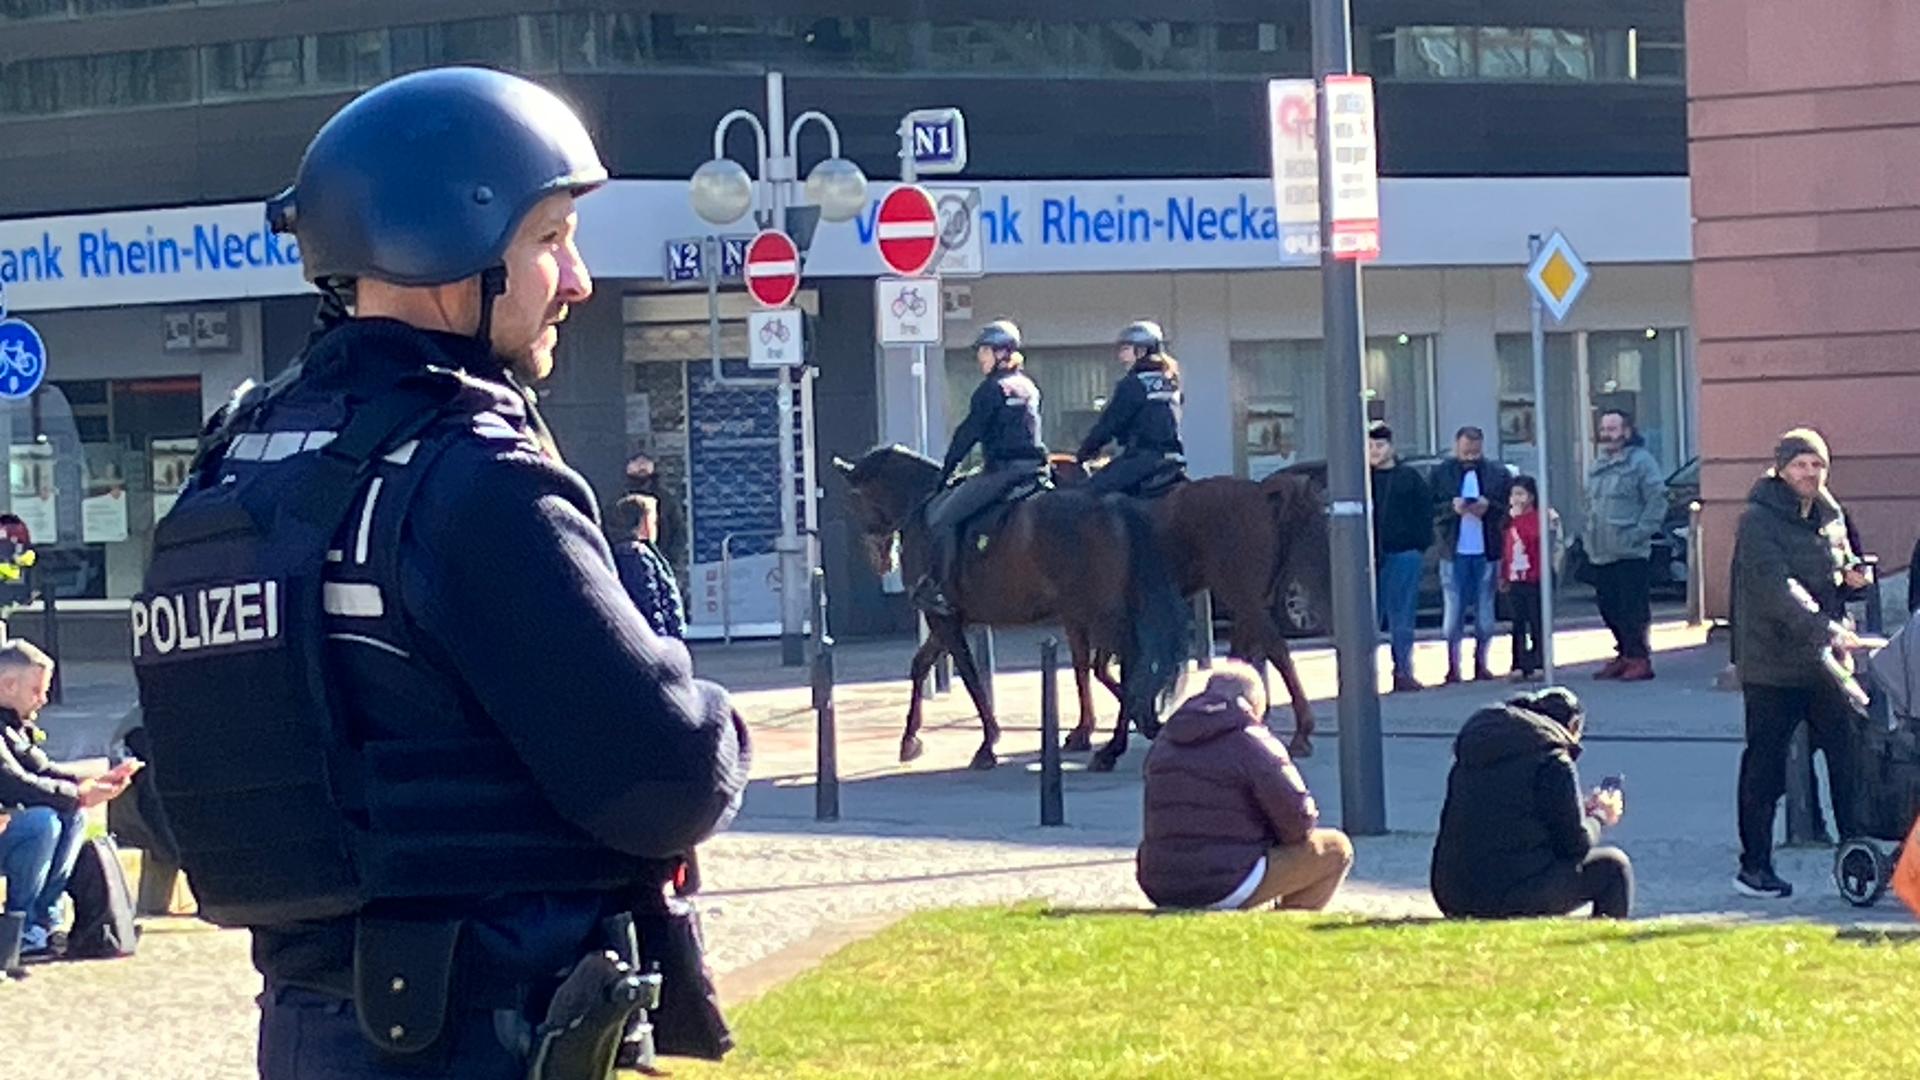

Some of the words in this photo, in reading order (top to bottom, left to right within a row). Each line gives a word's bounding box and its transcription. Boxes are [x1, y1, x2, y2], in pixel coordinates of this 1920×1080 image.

[915, 127, 952, 156] N1
[1043, 194, 1279, 244] Rhein-Necka
[0, 231, 64, 283] ank
[79, 223, 301, 278] Rhein-Necka
[669, 243, 698, 269] N2
[725, 240, 744, 265] N
[131, 580, 278, 658] POLIZEI
